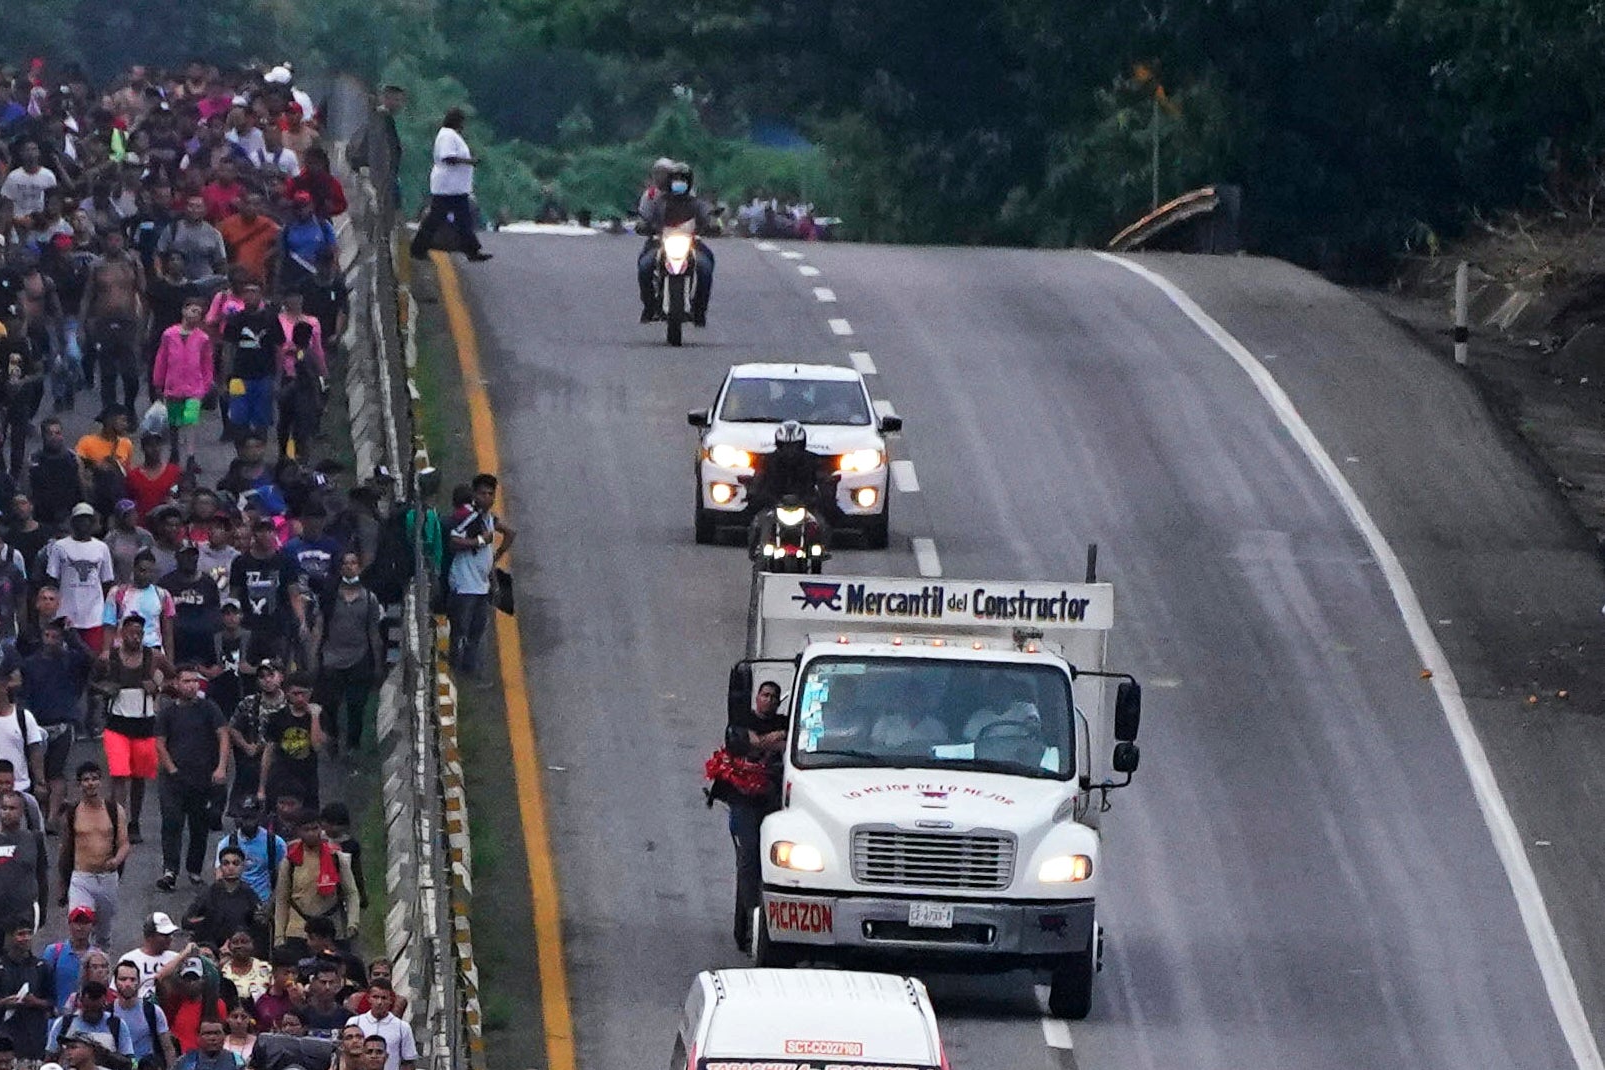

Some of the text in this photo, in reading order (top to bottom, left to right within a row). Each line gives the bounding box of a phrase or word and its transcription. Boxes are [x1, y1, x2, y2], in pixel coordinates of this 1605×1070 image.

[845, 583, 1091, 622] Mercantil del Constructor
[768, 901, 833, 933] PICAZON
